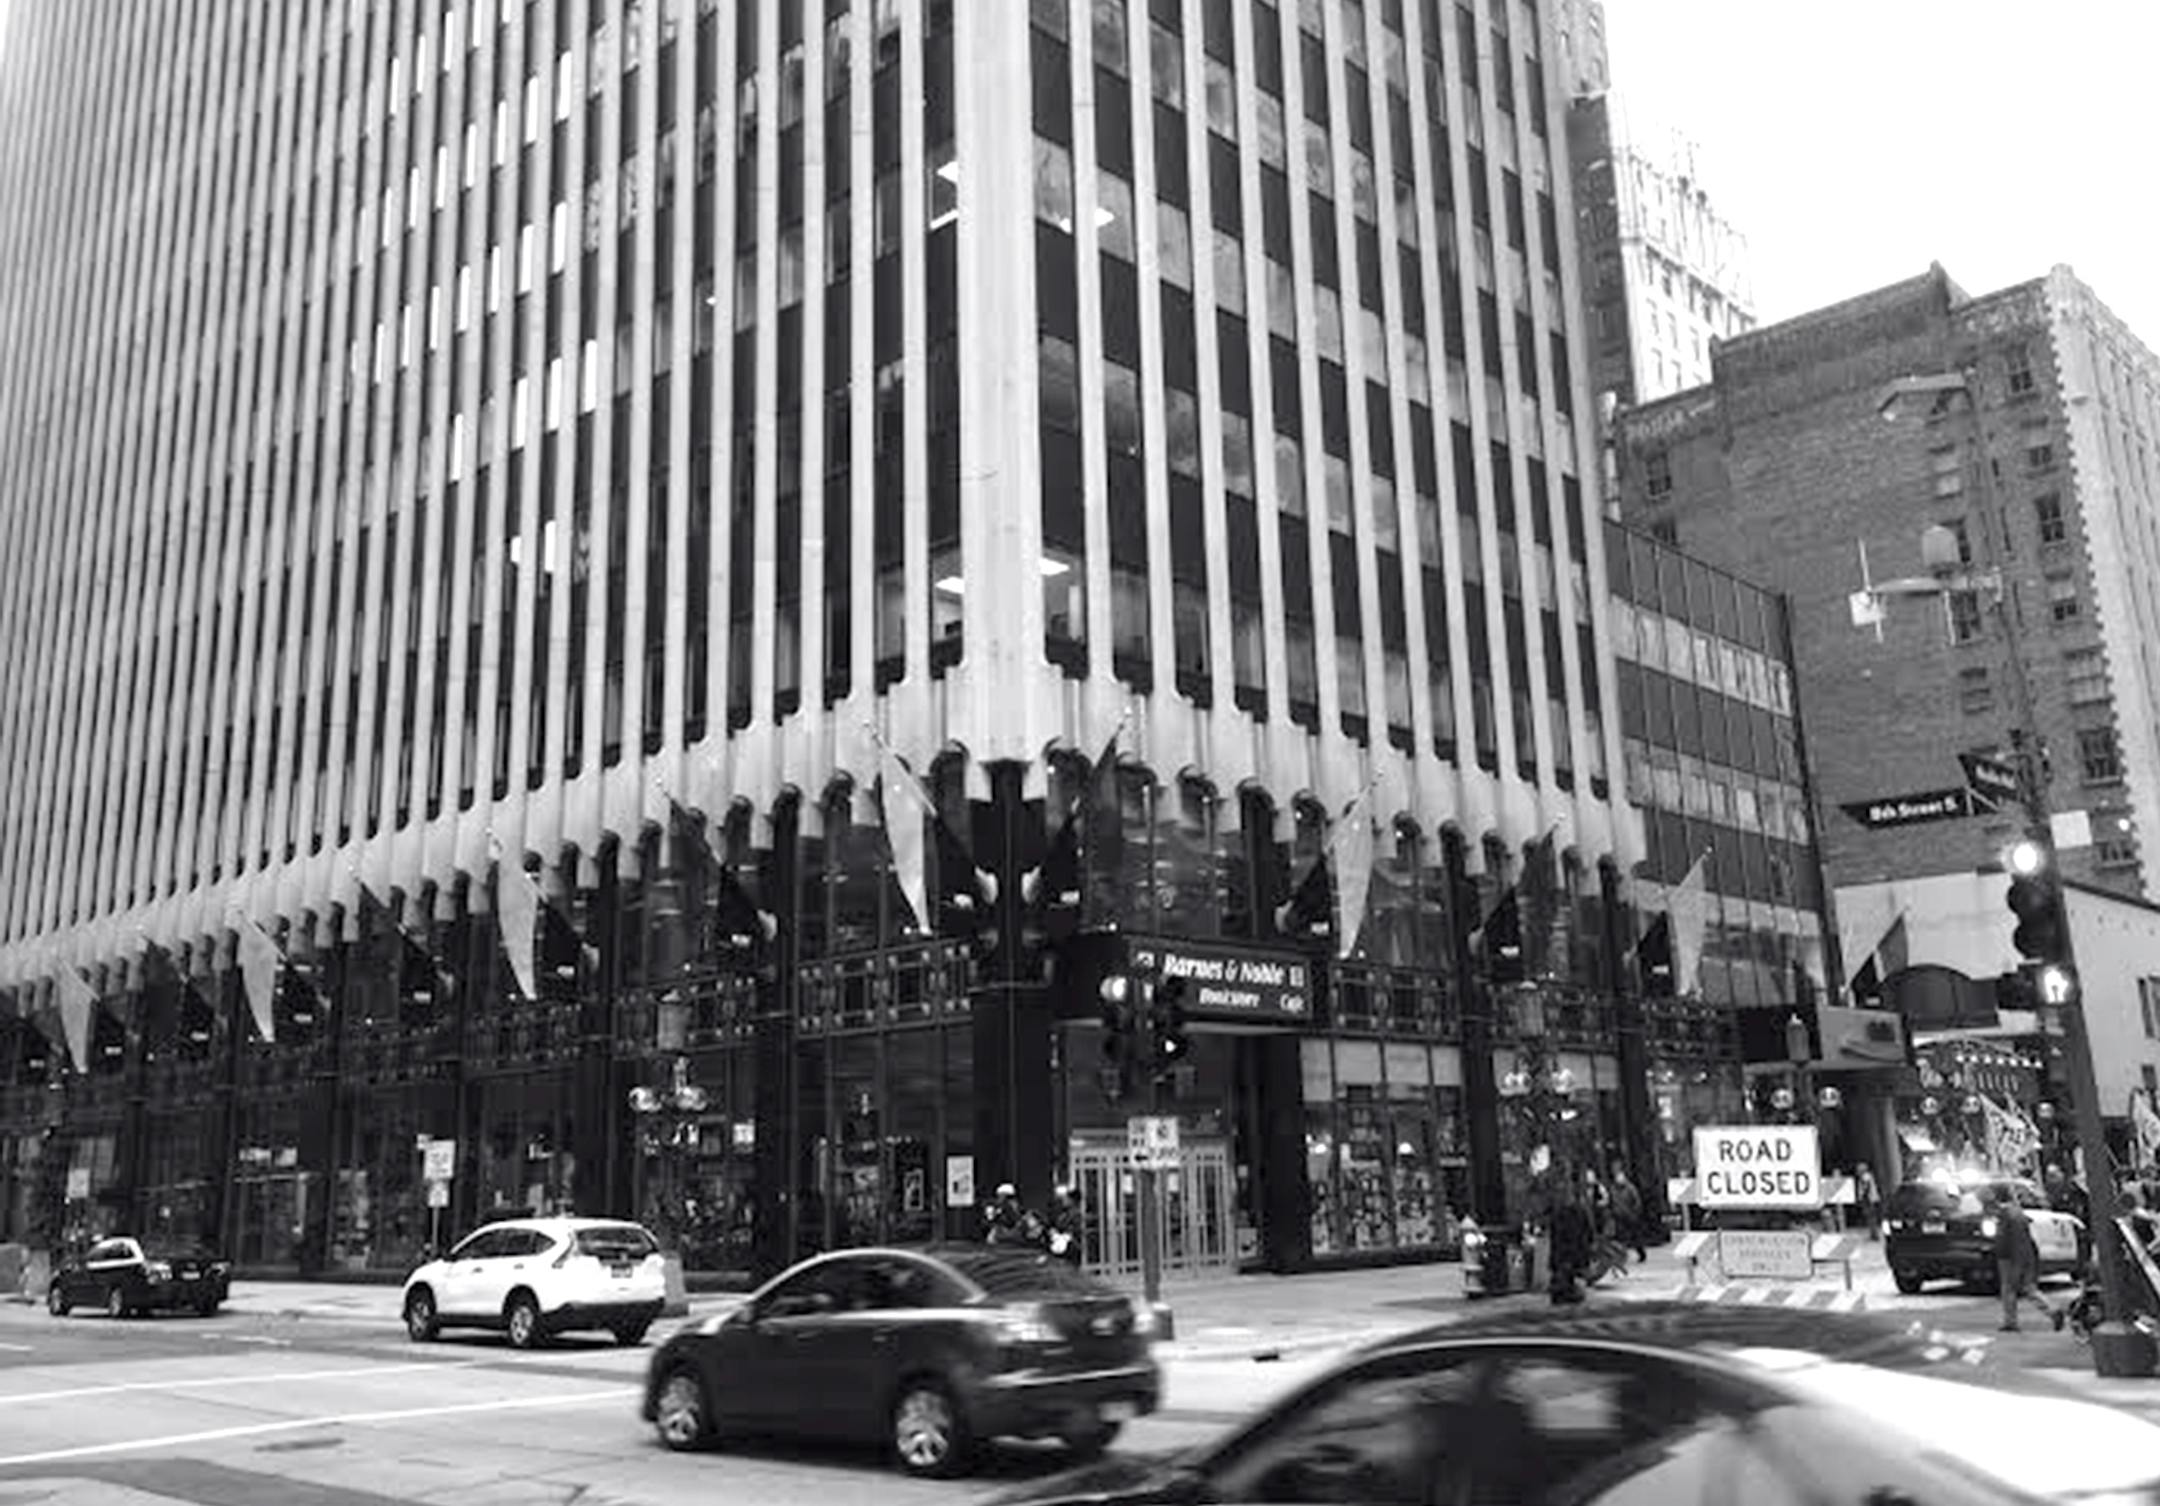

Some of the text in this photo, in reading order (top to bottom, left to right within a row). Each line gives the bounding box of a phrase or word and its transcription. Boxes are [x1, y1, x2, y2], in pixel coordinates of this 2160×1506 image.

[1869, 803, 1897, 821] 8th
[1898, 801, 1943, 818] Street
[1163, 953, 1223, 980] Barnes
[1225, 958, 1237, 982] &
[1239, 961, 1285, 985] Noble
[1719, 1138, 1792, 1162] ROAD
[1707, 1170, 1811, 1195] CLOSED
